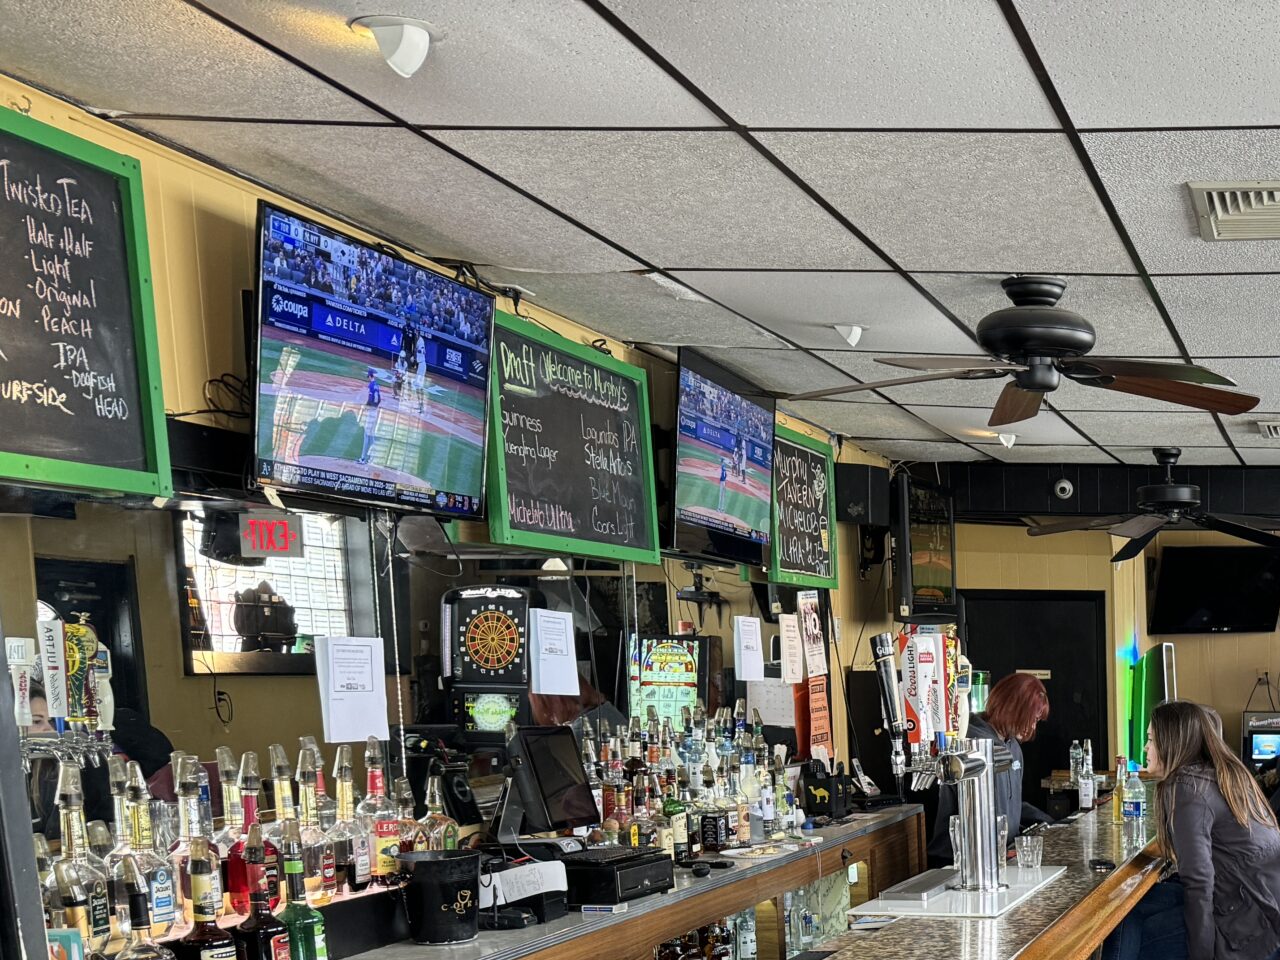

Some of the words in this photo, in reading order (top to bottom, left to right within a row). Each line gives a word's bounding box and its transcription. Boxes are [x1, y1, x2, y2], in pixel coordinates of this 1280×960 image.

[56, 178, 93, 224] TEA
[30, 249, 71, 288] Light
[42, 304, 93, 339] PEACH
[283, 299, 309, 318] coupa
[335, 316, 366, 335] DELTA
[50, 342, 90, 370] IPA
[500, 341, 536, 388] Draft
[540, 351, 584, 389] Welcome
[95, 394, 129, 420] HEAD
[499, 395, 543, 432] Guinness
[622, 420, 639, 456] IPA
[584, 443, 609, 471] Stella
[307, 468, 320, 478] PLAY
[325, 472, 339, 481] WEST
[339, 474, 369, 486] SACRAMENTO
[778, 478, 816, 508] TAVERN
[906, 644, 915, 670] LIGHT
[906, 669, 918, 698] Coors
